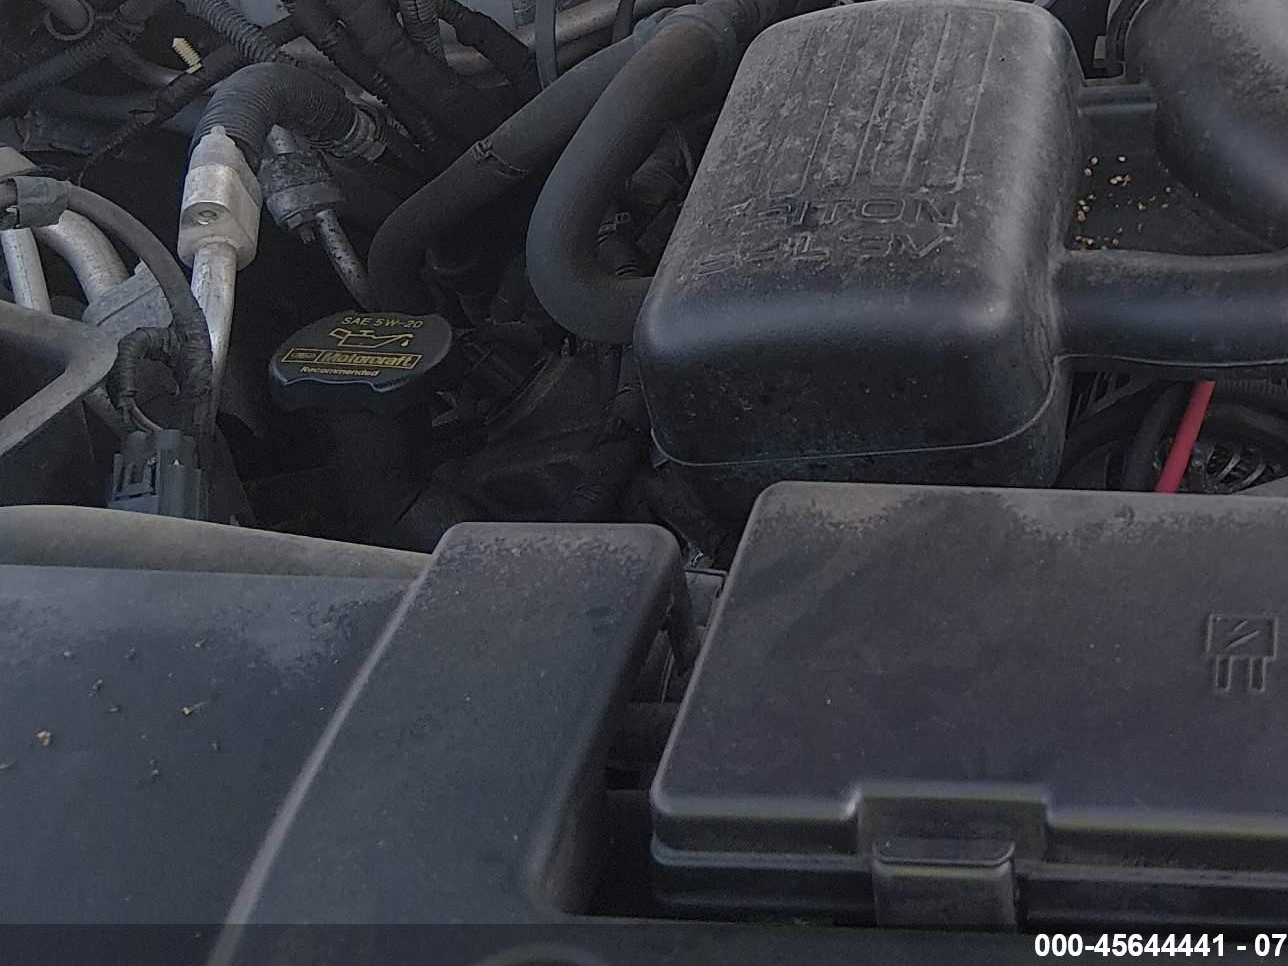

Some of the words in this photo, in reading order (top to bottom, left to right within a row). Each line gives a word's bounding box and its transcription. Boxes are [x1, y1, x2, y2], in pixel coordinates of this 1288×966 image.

[342, 316, 373, 327] SAE
[374, 318, 424, 329] 5W-20
[320, 352, 414, 367] Motorcraft
[299, 365, 380, 377] Recommended
